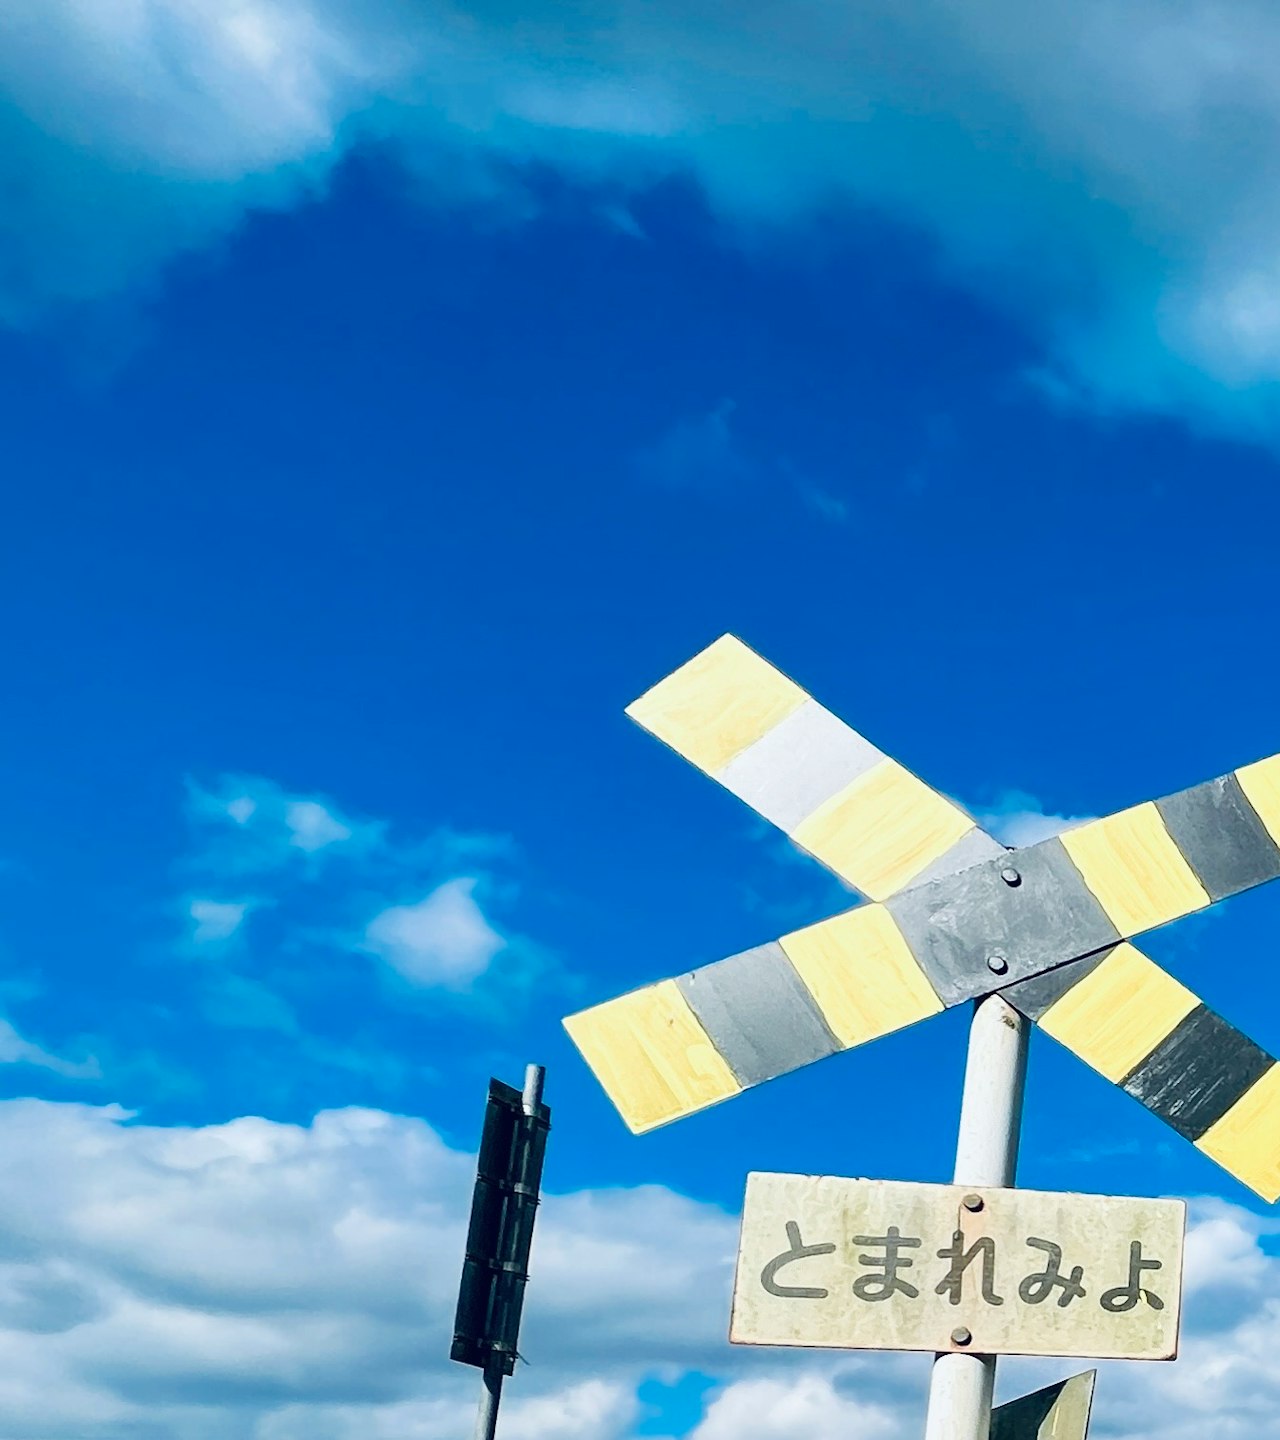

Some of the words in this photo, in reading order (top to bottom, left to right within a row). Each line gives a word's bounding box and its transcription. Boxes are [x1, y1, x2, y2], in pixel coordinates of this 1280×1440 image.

[760, 1220, 1165, 1312] とまれみよ
